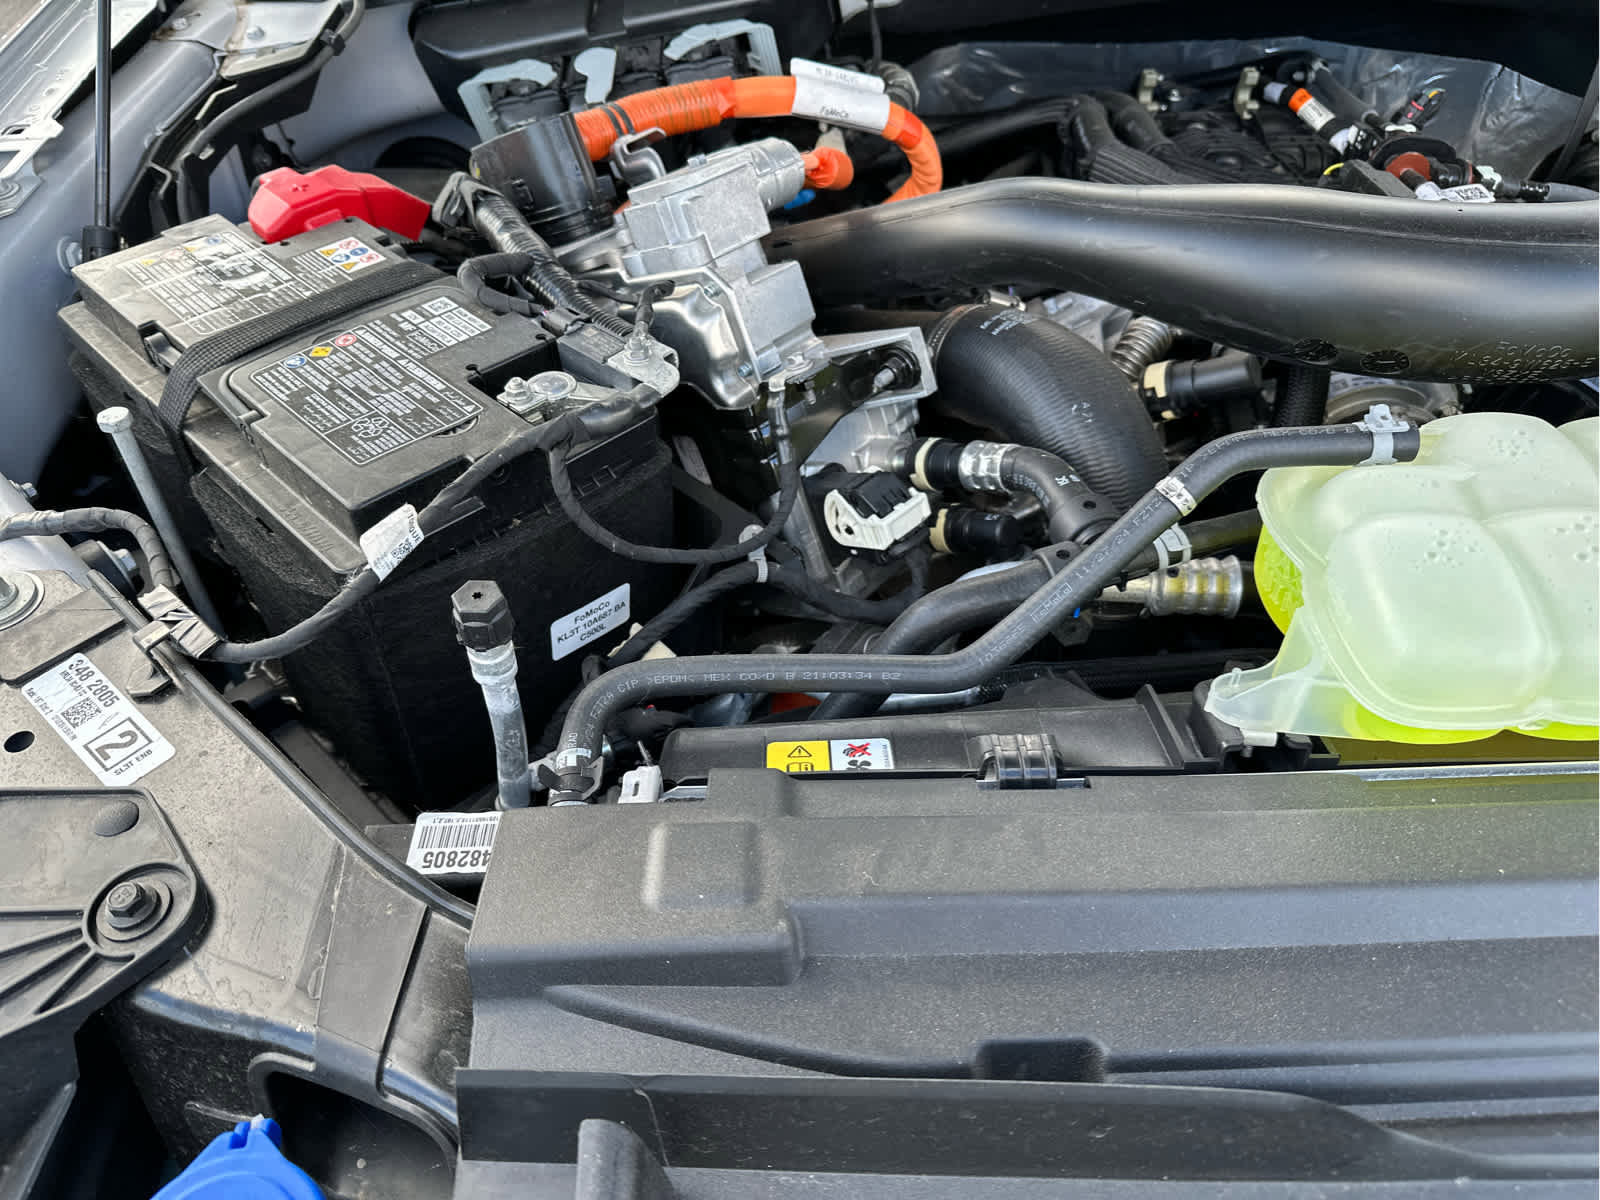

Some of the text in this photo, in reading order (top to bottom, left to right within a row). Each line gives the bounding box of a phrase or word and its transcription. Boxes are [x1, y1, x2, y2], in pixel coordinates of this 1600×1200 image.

[574, 601, 610, 624] FoMoCo
[68, 659, 95, 682] 348
[87, 679, 120, 708] 2805
[704, 673, 731, 682] MEX
[95, 730, 138, 761] 2
[422, 849, 491, 869] 482805
